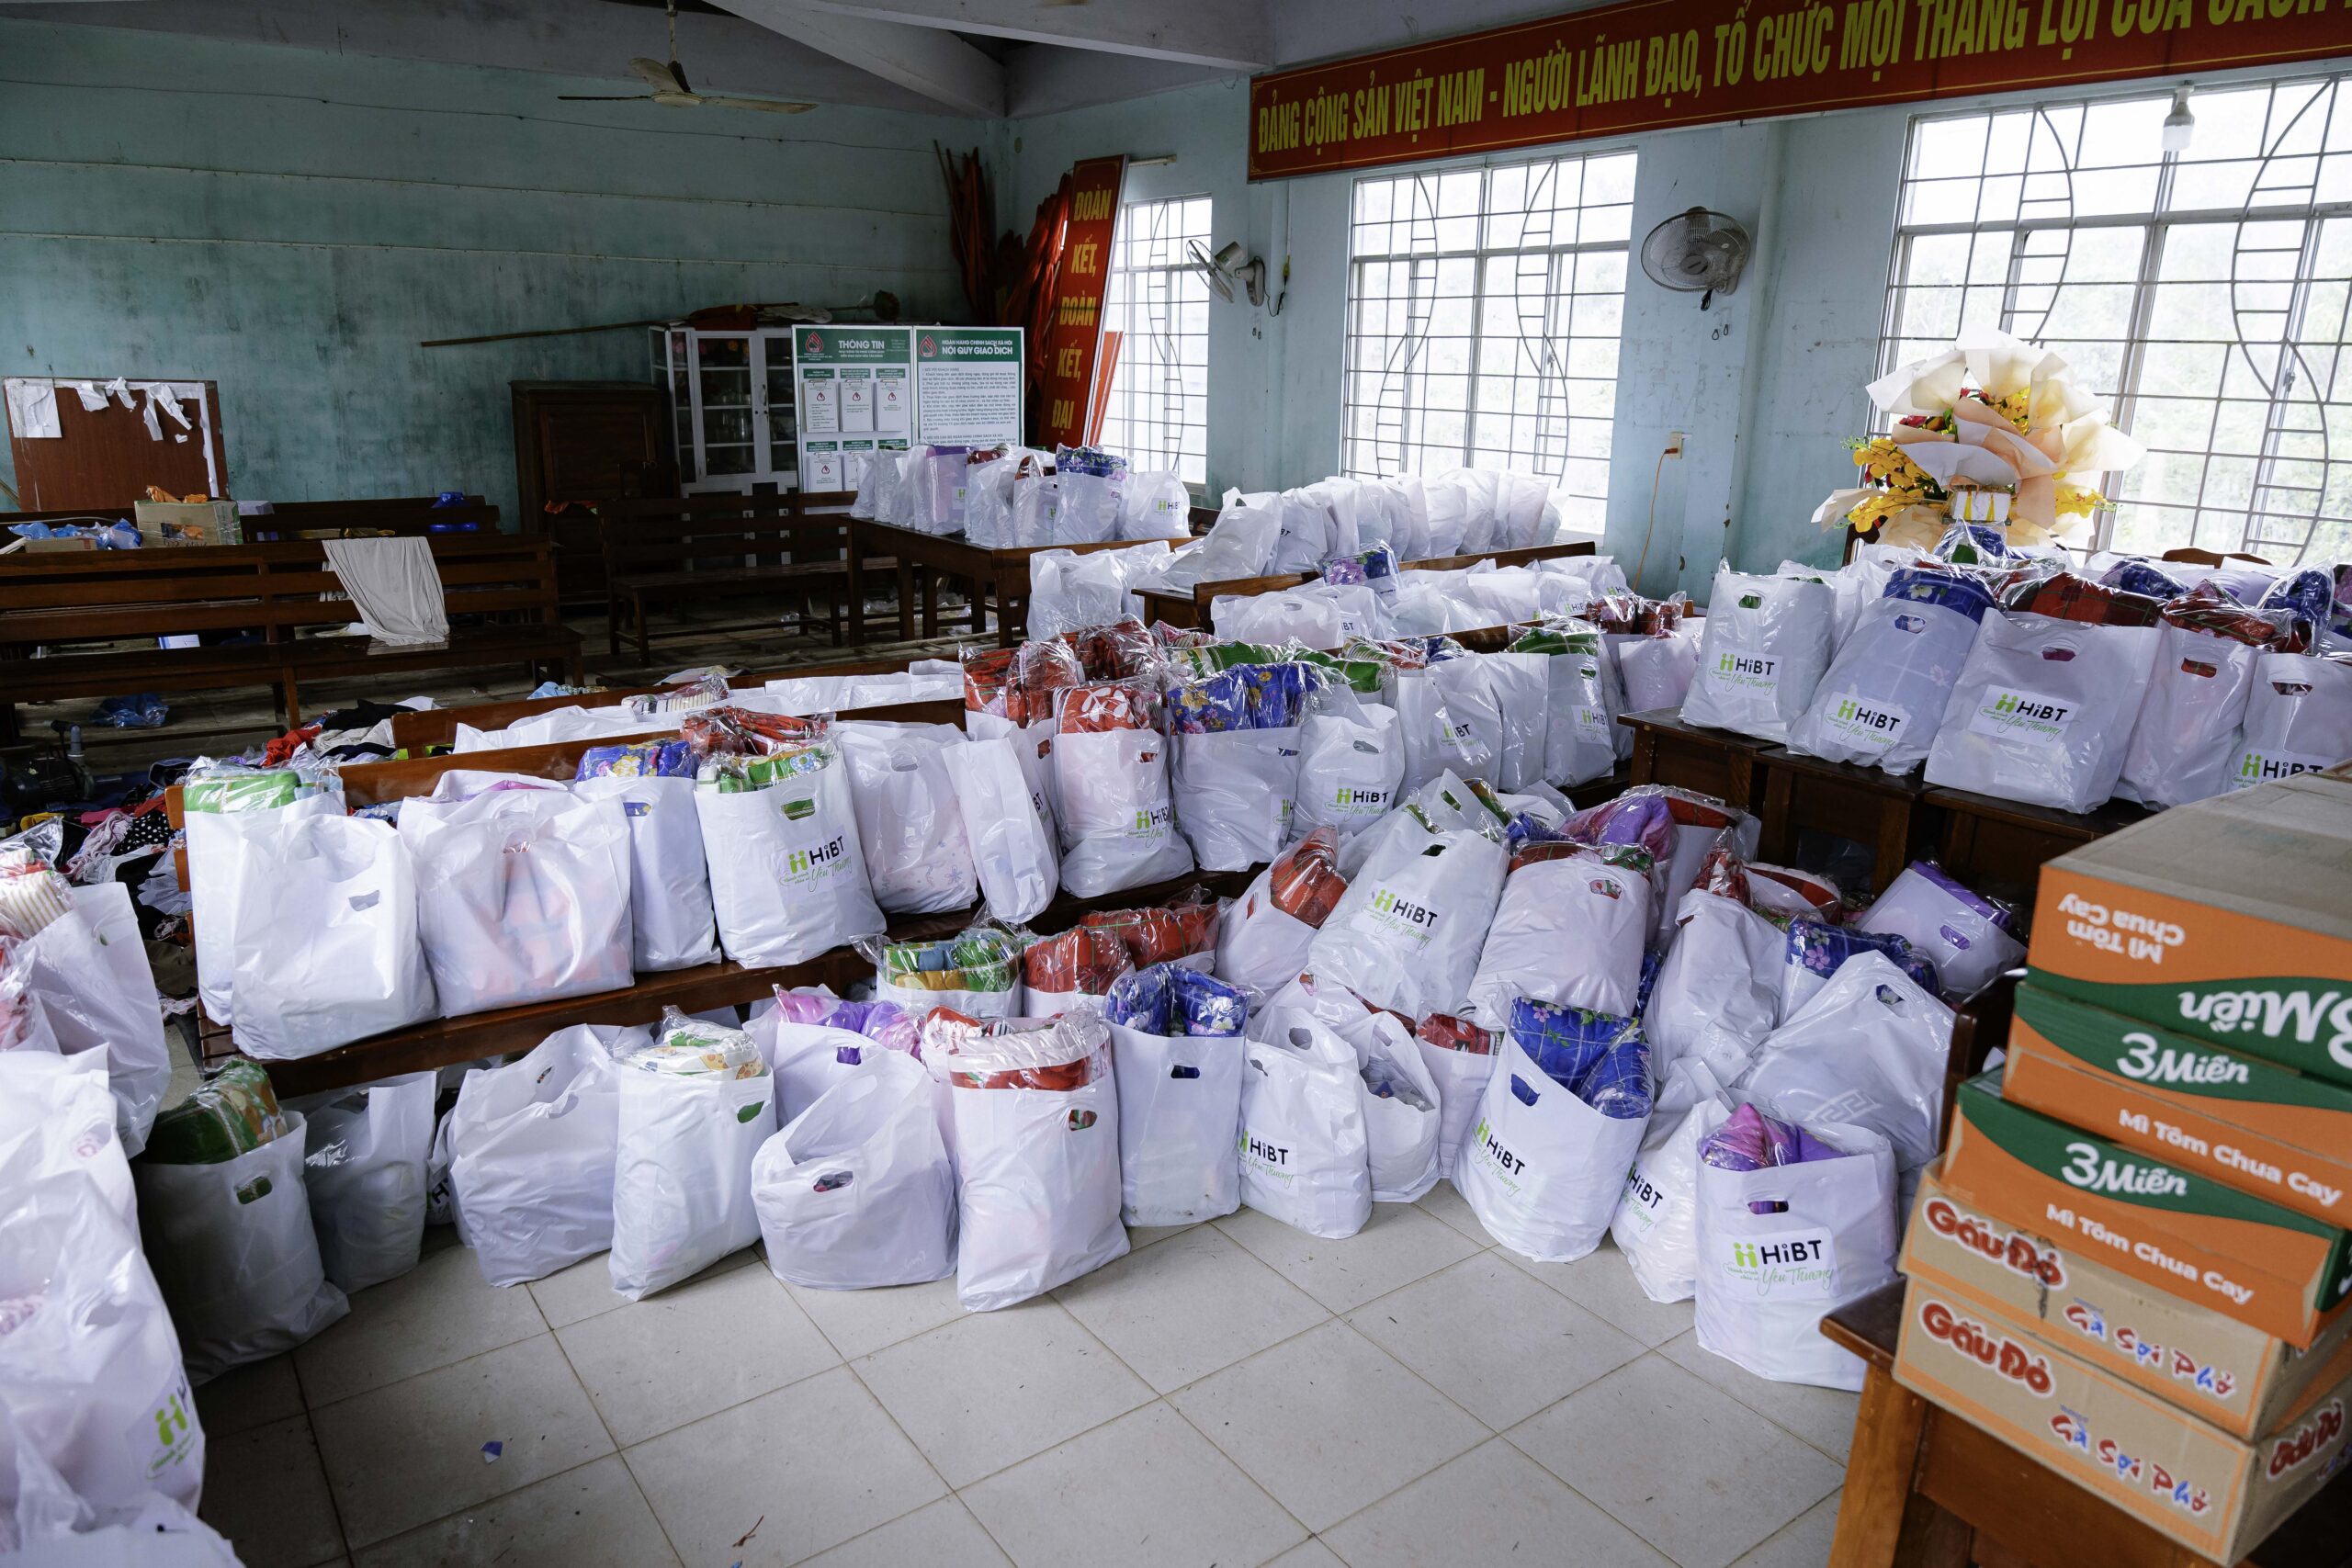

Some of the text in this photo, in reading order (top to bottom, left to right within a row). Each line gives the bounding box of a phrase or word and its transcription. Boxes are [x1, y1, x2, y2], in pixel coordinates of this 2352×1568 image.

[1259, 89, 1300, 153] ĐẢNG
[1305, 86, 1349, 155] CỘNG
[1353, 70, 1389, 140] SẢN
[1395, 68, 1434, 143] VIỆT
[1437, 68, 1485, 127] NAM
[1503, 39, 1572, 117] NGƯỜI
[1577, 33, 1641, 107] LÃNH
[1645, 28, 1702, 108] ĐẠO,
[1753, 0, 1834, 82] CHỨC
[1839, 0, 1906, 82] MỌI
[838, 339, 870, 349] THÔNG
[871, 340, 885, 349] TIN
[957, 346, 972, 355] QUY
[974, 346, 992, 355] GIAO
[1736, 658, 1775, 675] HiBT
[1855, 706, 1901, 731] HiBT
[2016, 701, 2068, 722] HiBT
[1353, 791, 1388, 803] HiBT
[1150, 807, 1168, 825] HiB
[808, 835, 843, 865] HiBT
[1393, 898, 1438, 928] HiBT
[2057, 893, 2186, 946] Chua Cay
[2067, 919, 2124, 953] Tôm
[1250, 1137, 1289, 1166] HiBT
[1487, 1134, 1526, 1176] HiBT
[2154, 1121, 2209, 1157] Tôm
[2212, 1144, 2283, 1185] Chua
[2287, 1171, 2343, 1207] Cay
[1628, 1168, 1663, 1209] HiBT
[1760, 1239, 1822, 1265] HiBT
[2078, 1215, 2131, 1253] Tôm
[2133, 1241, 2199, 1283] Chua
[2202, 1269, 2255, 1304] Cay
